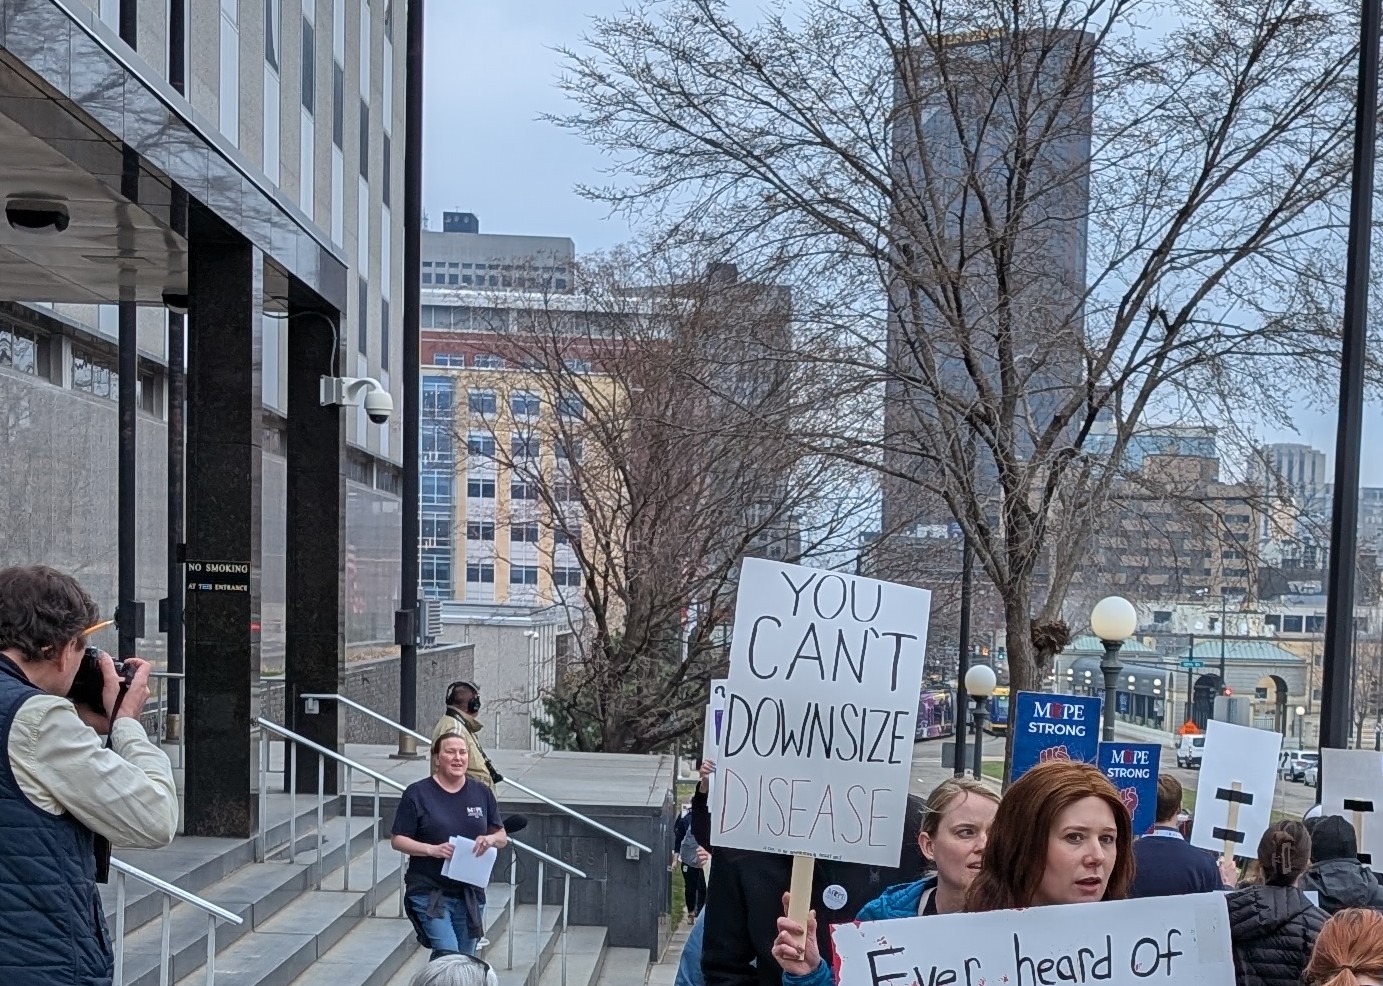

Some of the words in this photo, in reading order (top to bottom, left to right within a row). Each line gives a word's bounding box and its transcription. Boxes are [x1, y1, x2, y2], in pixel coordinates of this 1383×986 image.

[188, 563, 202, 572] NO
[206, 563, 248, 573] SMOKING
[780, 571, 882, 623] YOU
[748, 615, 918, 692] CAN'T
[724, 693, 910, 764] DOWNSIZE
[1028, 722, 1086, 737] STRONG
[1107, 767, 1150, 779] STRONG
[720, 768, 893, 847] DISEASE
